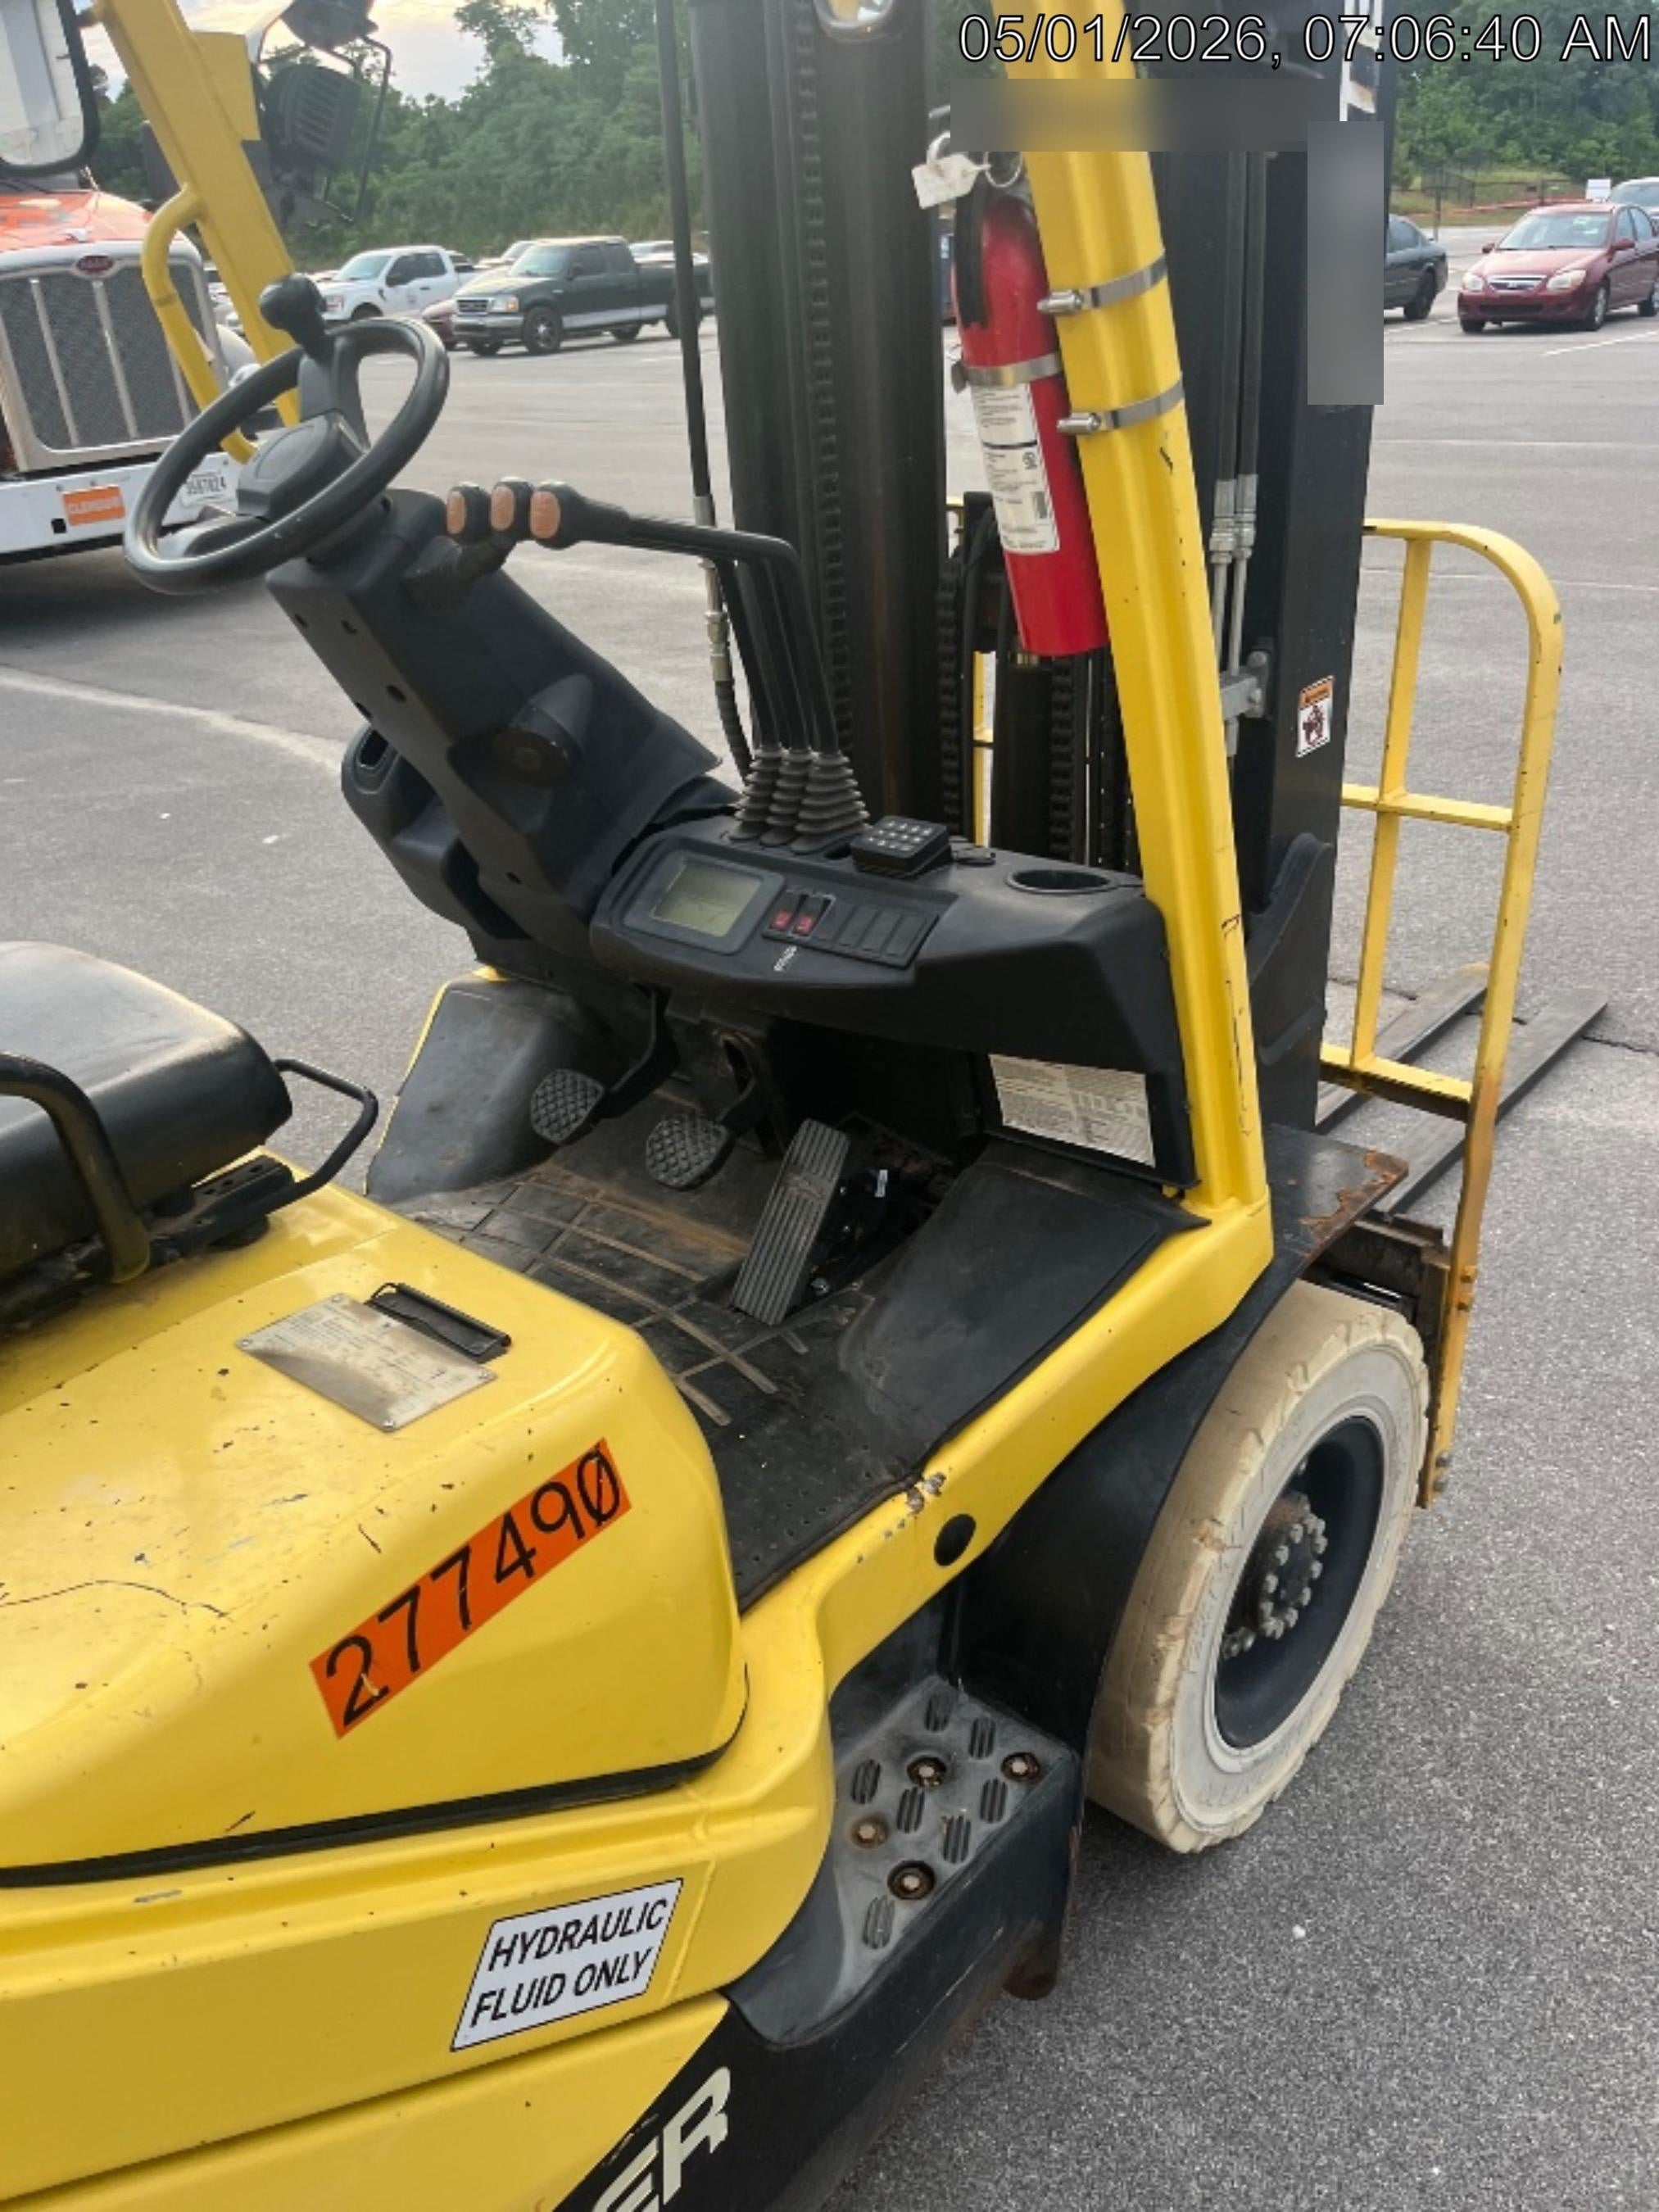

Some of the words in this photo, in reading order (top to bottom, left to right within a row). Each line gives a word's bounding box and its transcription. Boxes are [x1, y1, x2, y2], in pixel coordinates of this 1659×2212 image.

[326, 1444, 621, 1729] 277490
[488, 1899, 667, 1971] HYDRAULIC
[469, 1972, 565, 2027] FLUID
[573, 1947, 654, 1997] ONLY
